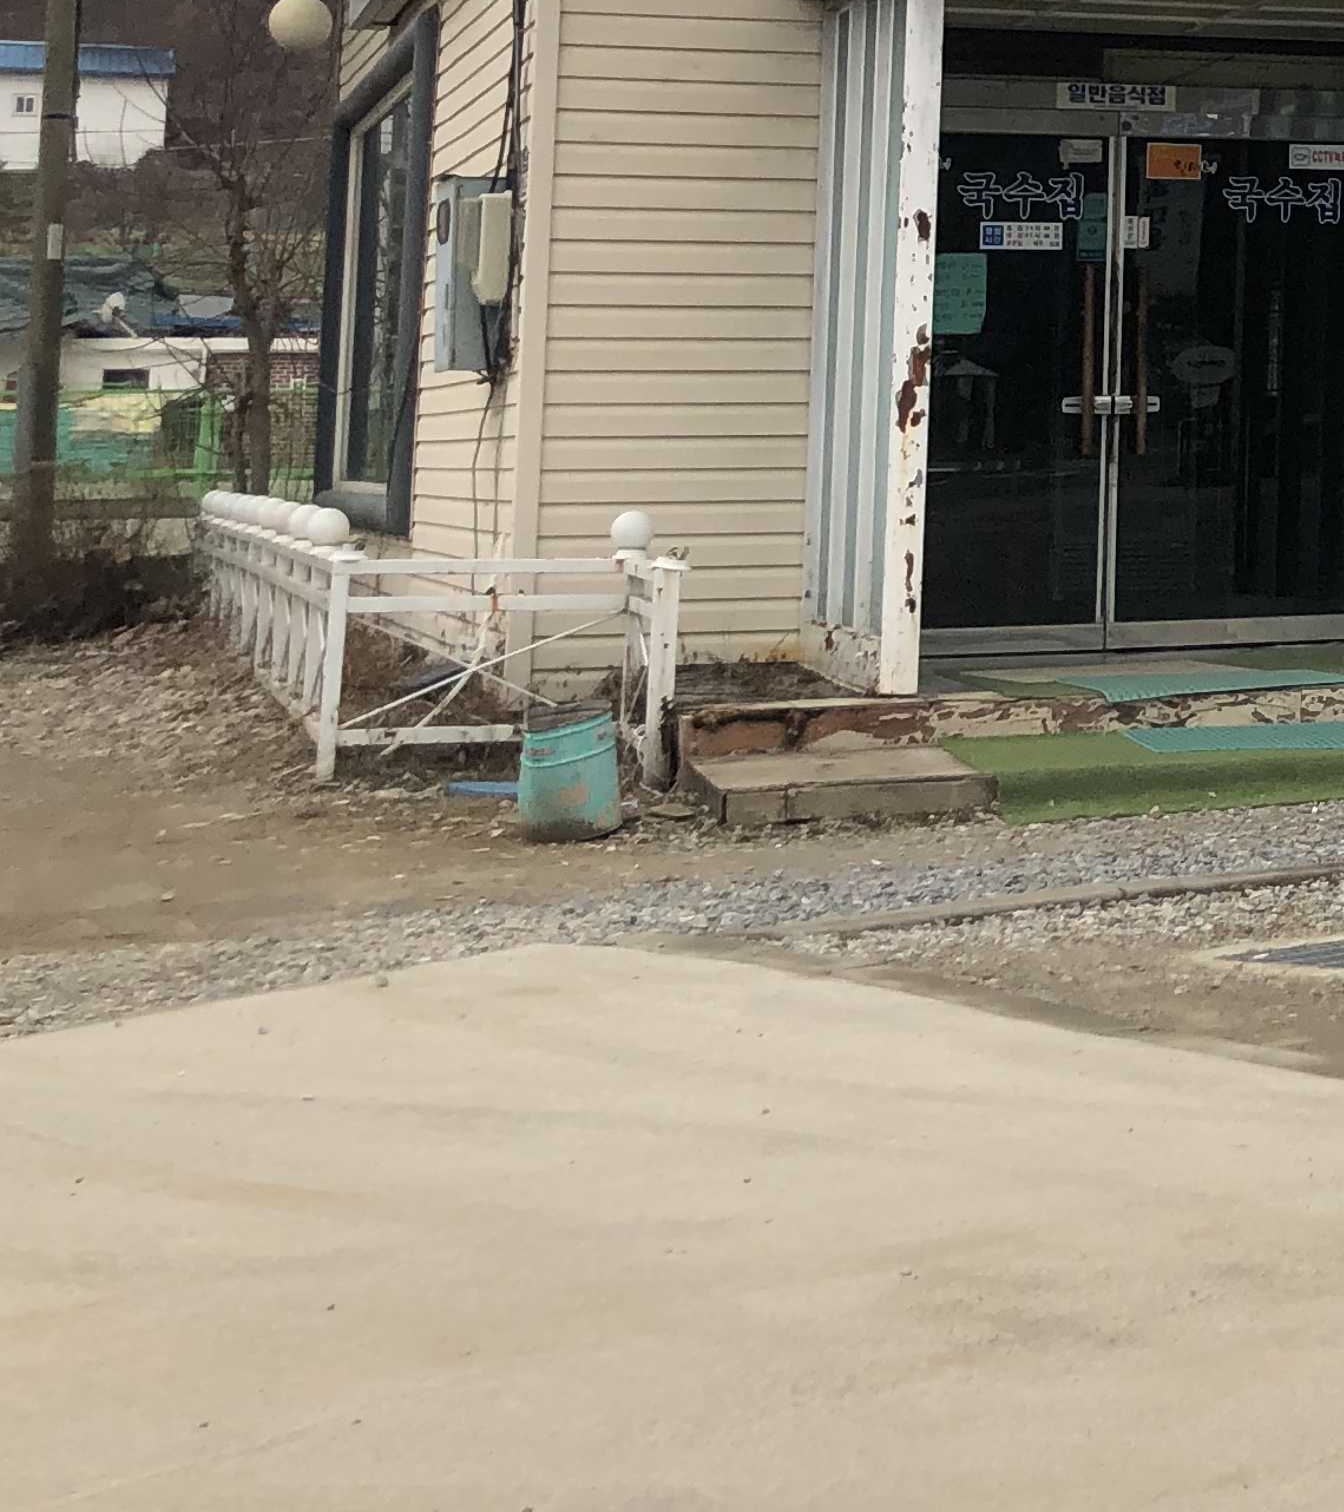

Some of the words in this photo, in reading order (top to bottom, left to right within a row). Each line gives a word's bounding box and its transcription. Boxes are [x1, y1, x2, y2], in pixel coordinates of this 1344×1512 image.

[1067, 83, 1166, 105] 일반음식점
[957, 171, 1085, 220] 국수집
[1222, 176, 1342, 225] 국수집
